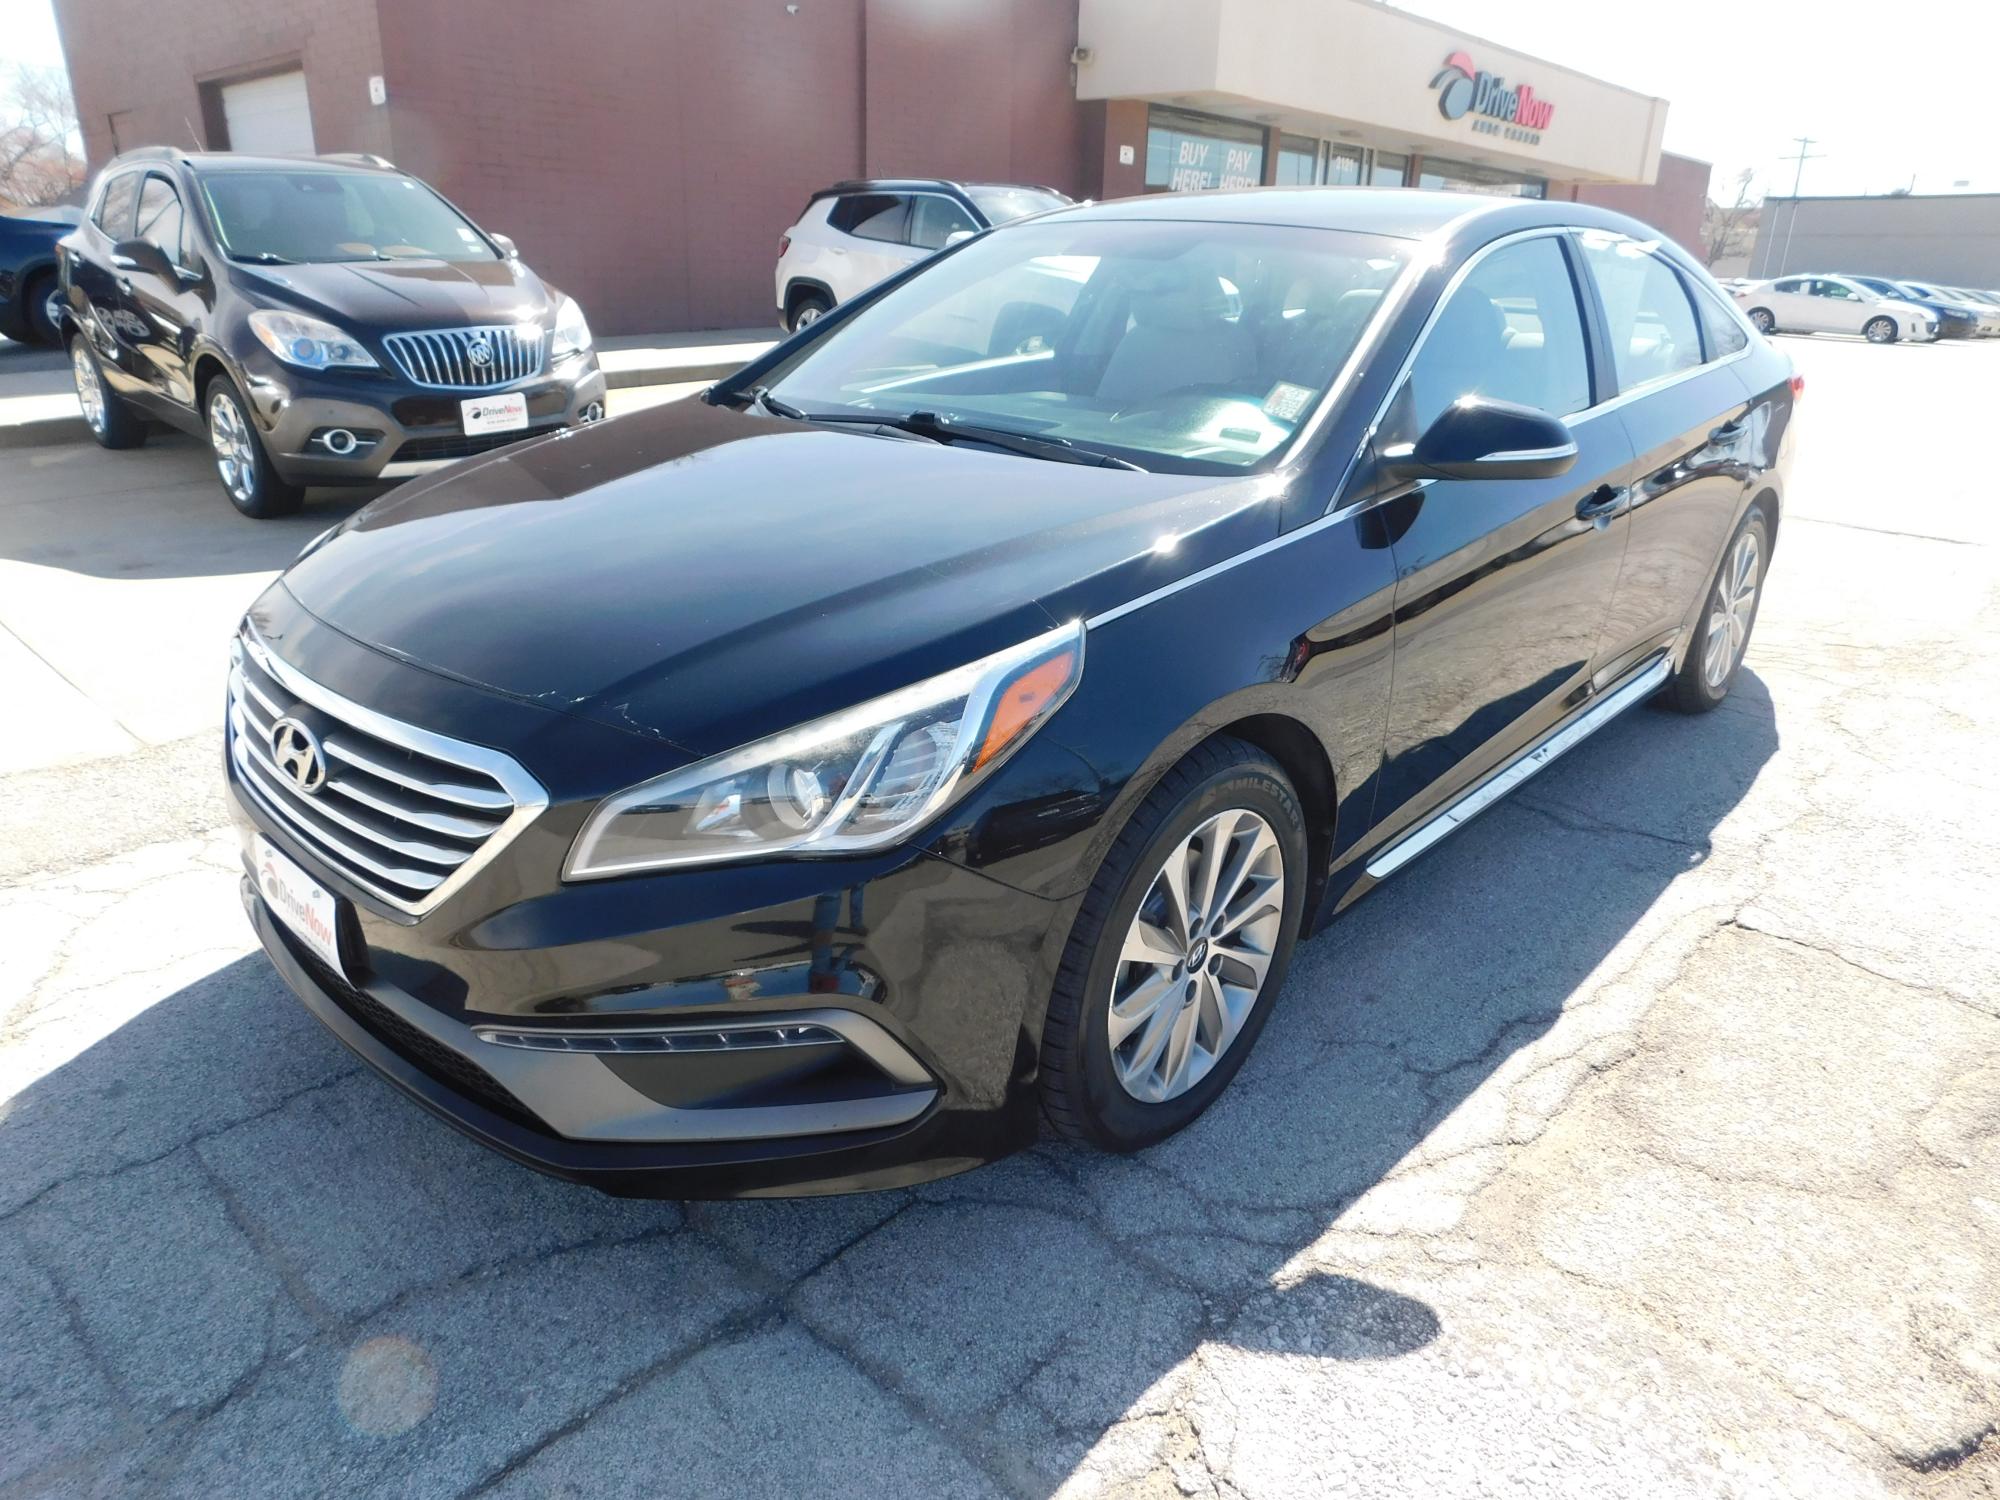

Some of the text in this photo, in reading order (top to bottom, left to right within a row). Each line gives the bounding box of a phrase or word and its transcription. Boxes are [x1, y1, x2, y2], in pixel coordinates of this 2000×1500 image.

[1474, 71, 1554, 130] DriveNow
[1179, 141, 1253, 172] BUY PAY
[1233, 777, 1300, 826] MILESTAR
[279, 878, 332, 946] DriveNow
